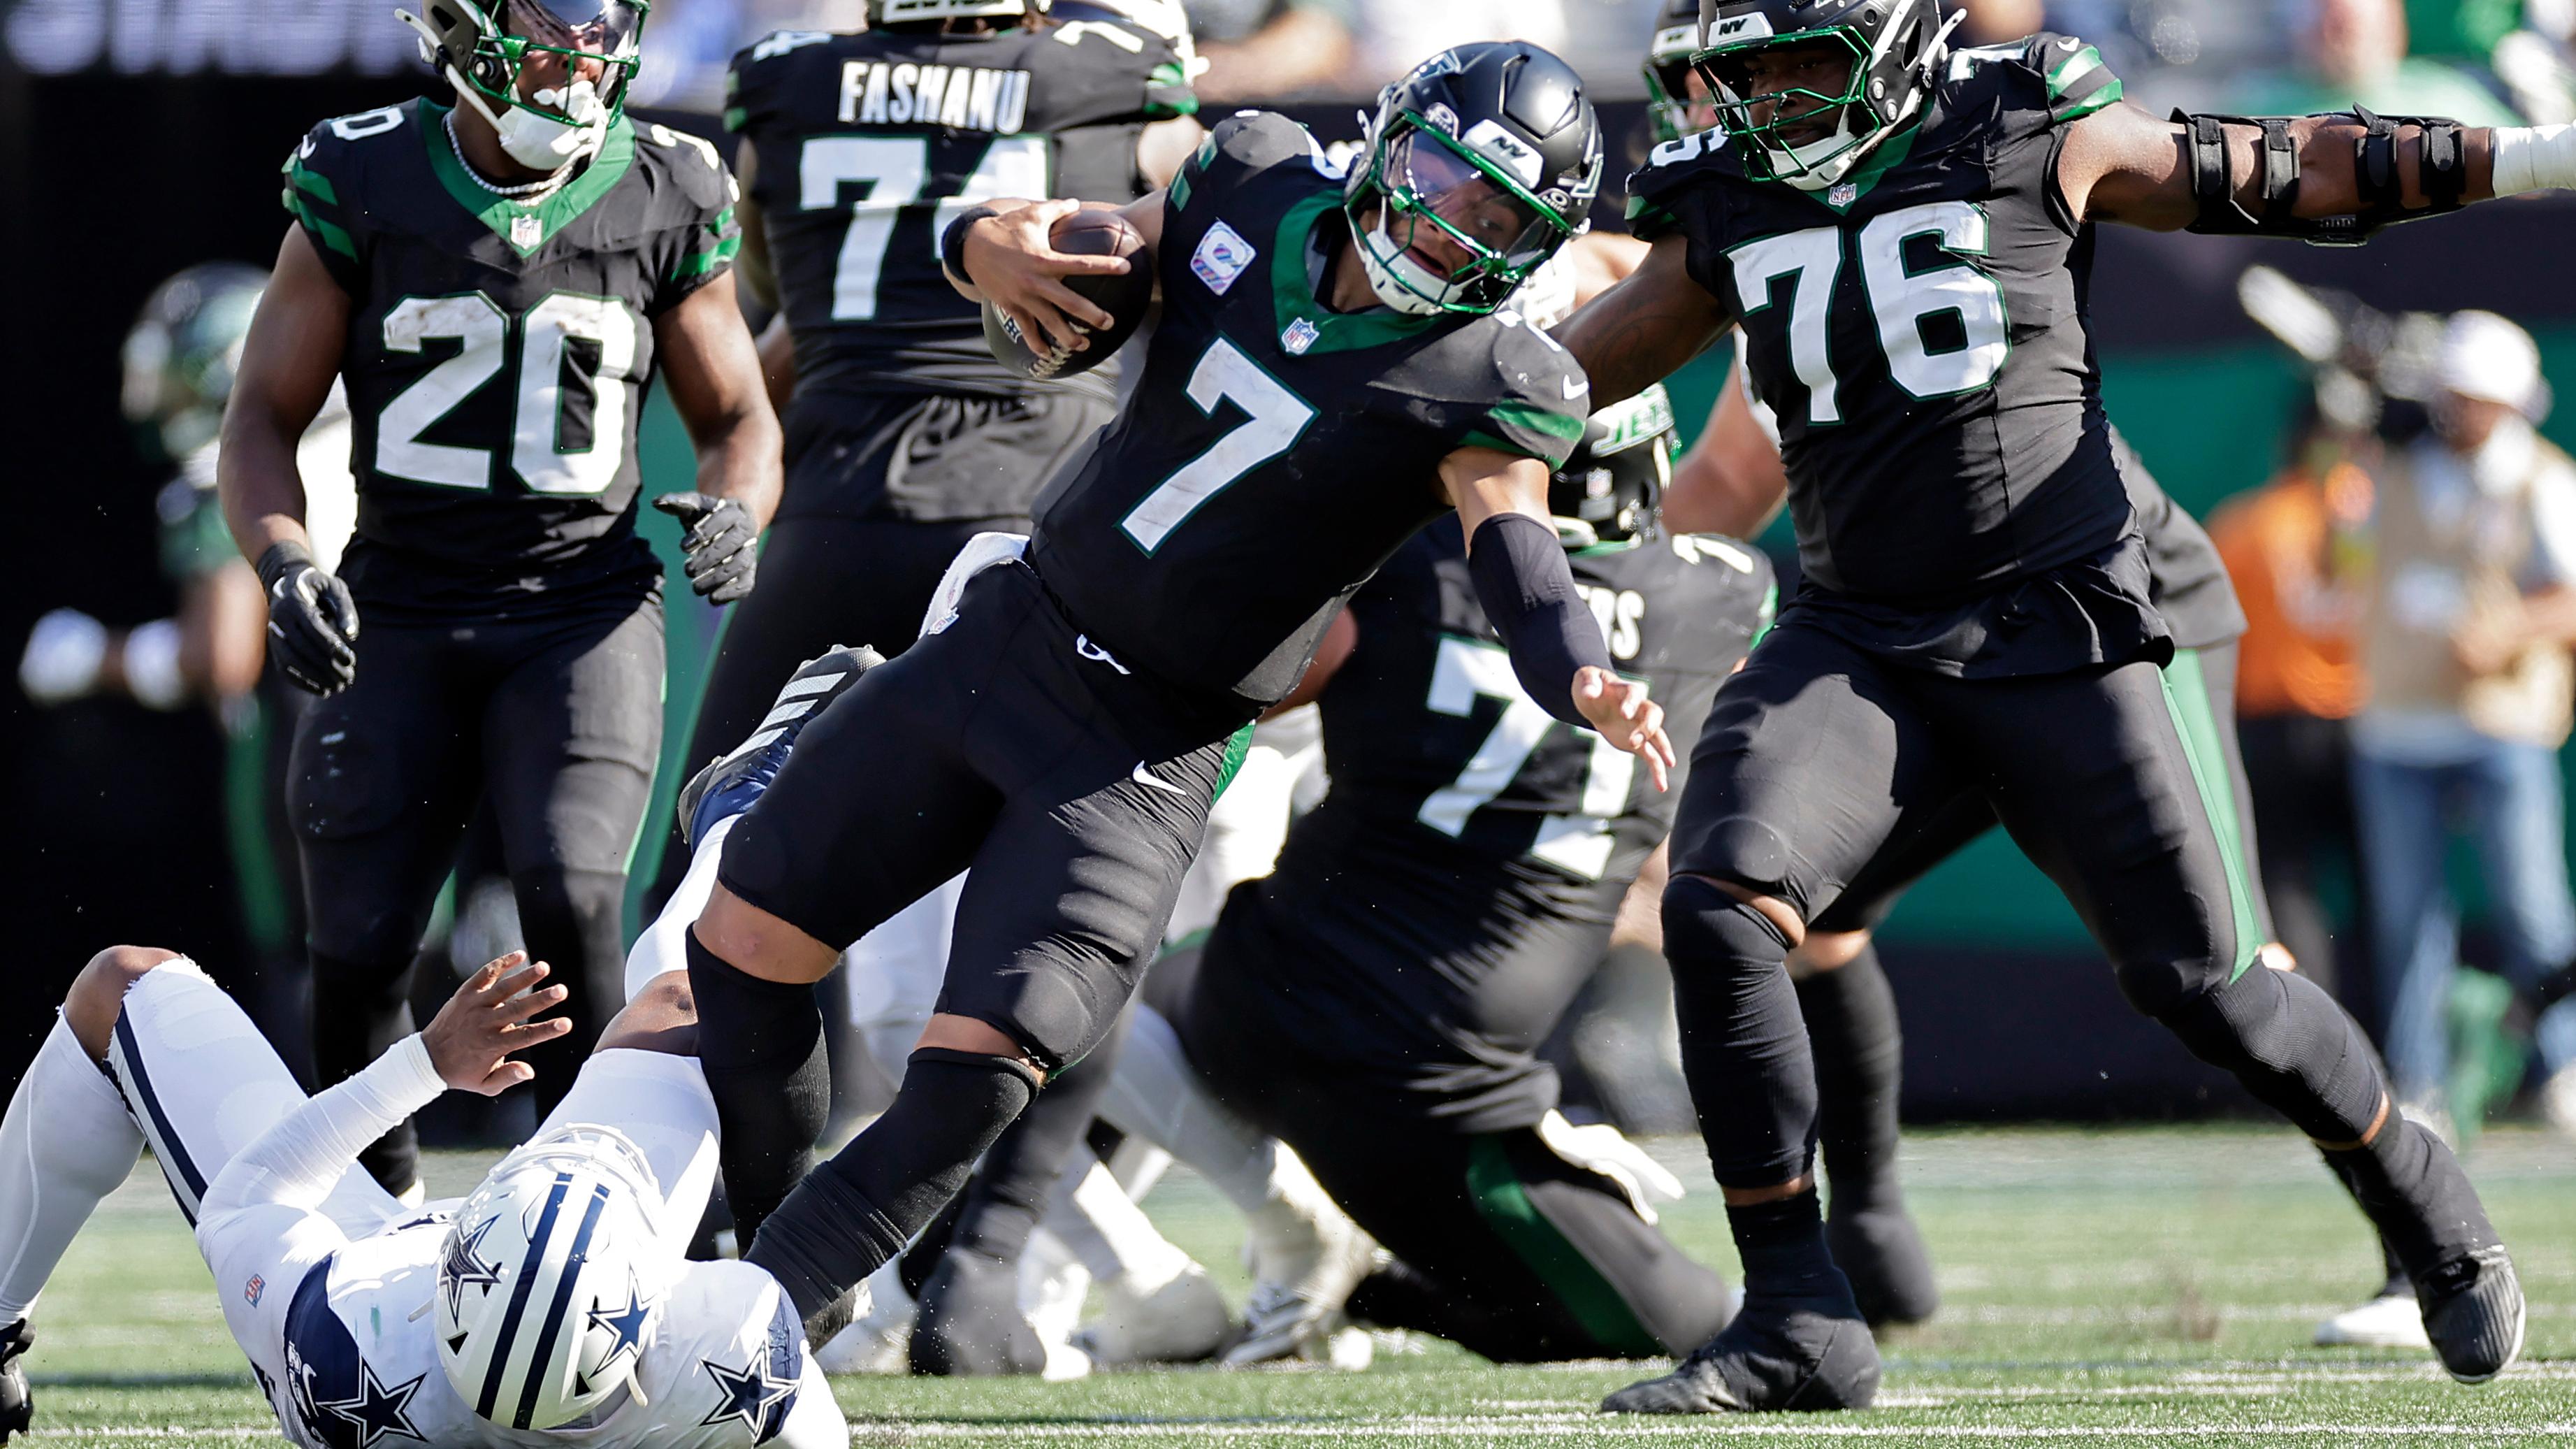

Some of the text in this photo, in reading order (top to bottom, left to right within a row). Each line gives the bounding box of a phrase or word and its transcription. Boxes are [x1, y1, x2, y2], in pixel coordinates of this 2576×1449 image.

[837, 60, 1031, 135] FASHANU
[1833, 191, 1851, 202] NFL
[1287, 330, 1310, 349] NFL
[1721, 199, 2012, 426] 76
[375, 290, 637, 496] 20
[1113, 331, 1321, 558] 7
[1417, 632, 1651, 880] 71
[245, 1276, 263, 1298] NFL
